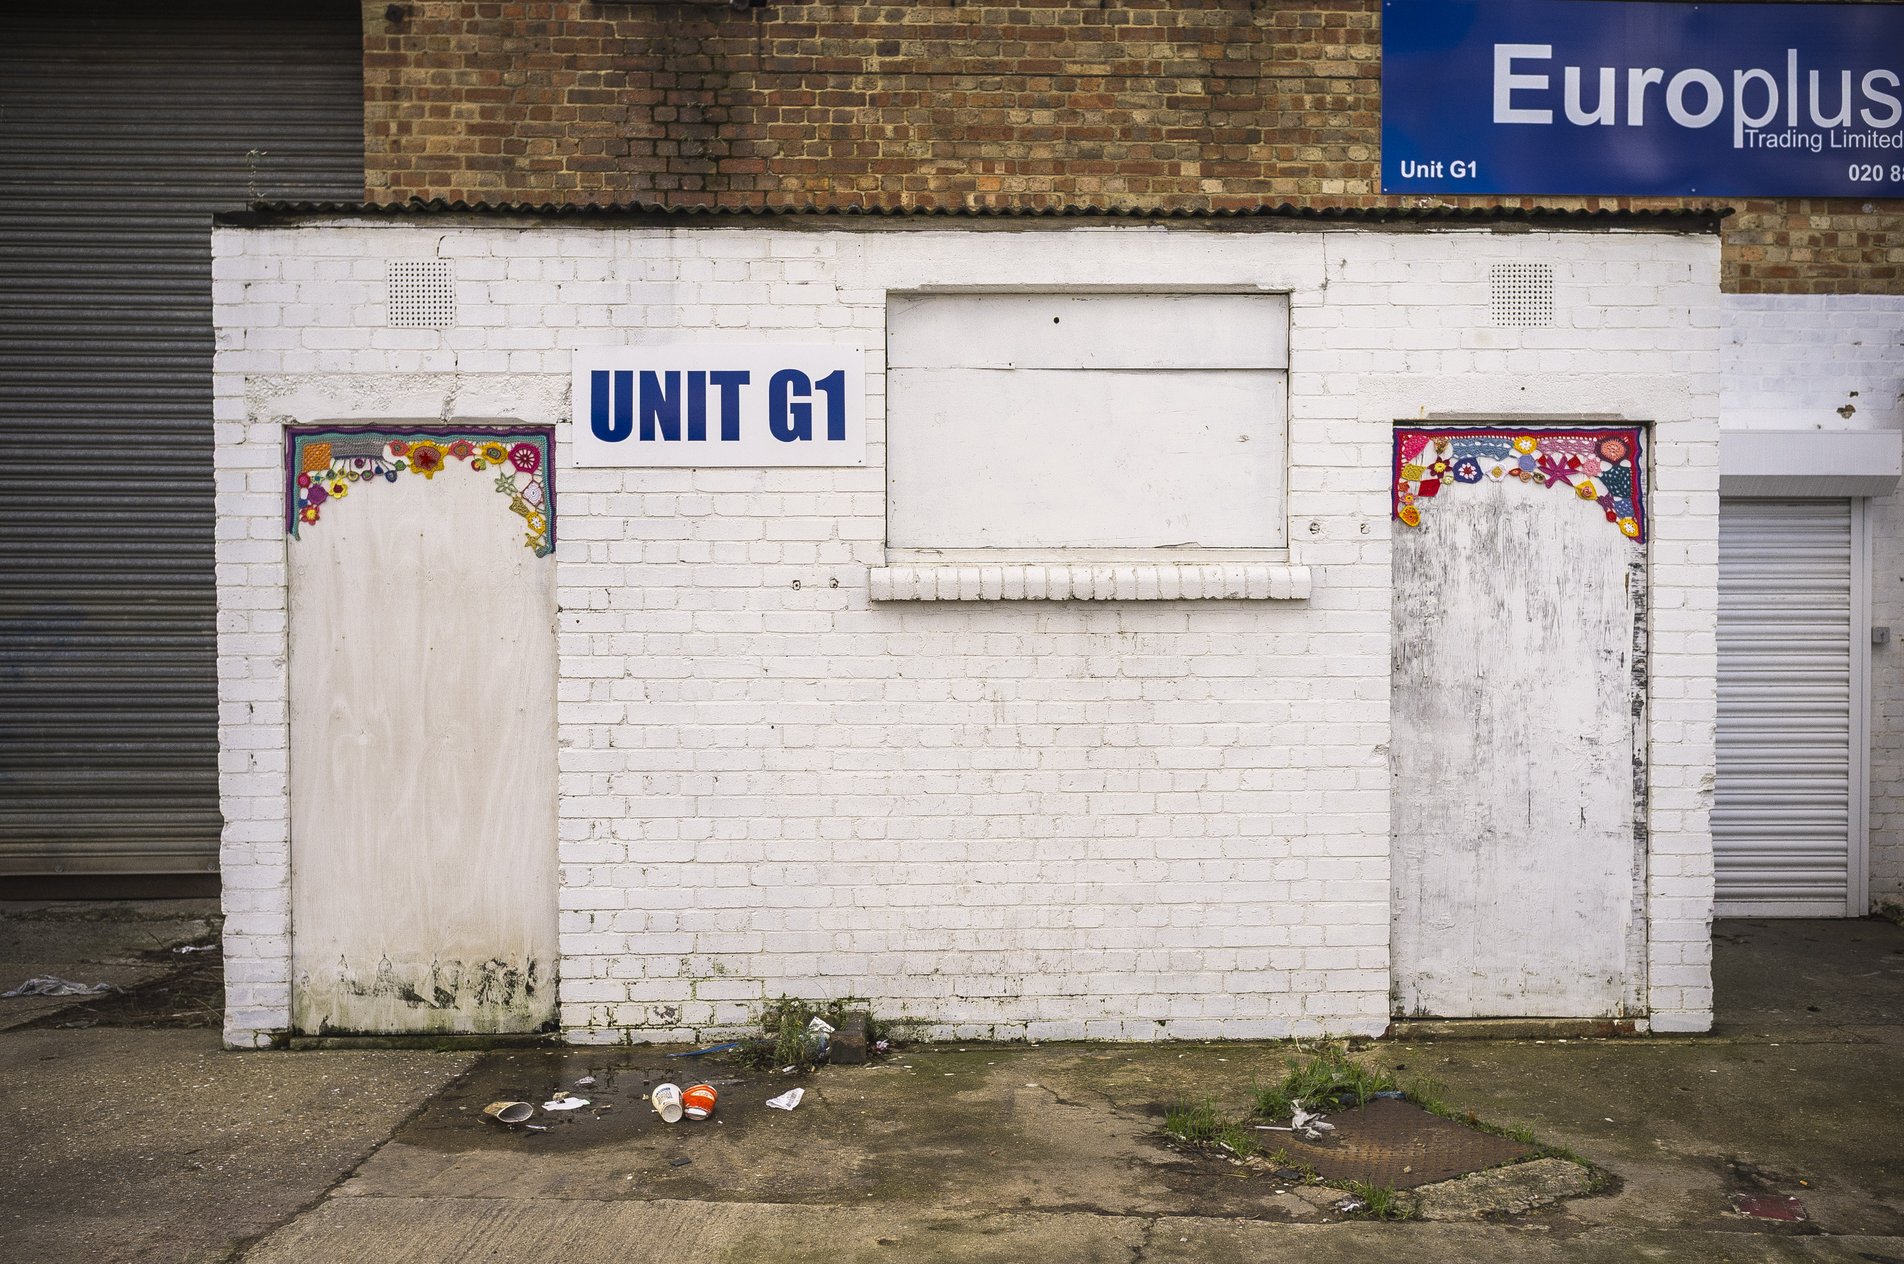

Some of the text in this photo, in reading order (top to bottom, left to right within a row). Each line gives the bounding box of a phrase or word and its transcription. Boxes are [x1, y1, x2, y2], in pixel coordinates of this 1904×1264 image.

[1493, 43, 1903, 149] Europlus
[1744, 129, 1903, 153] Trading Limited
[1400, 160, 1477, 179] Unit G1
[1848, 164, 1904, 182] 020 8
[590, 368, 846, 443] UNIT G1
